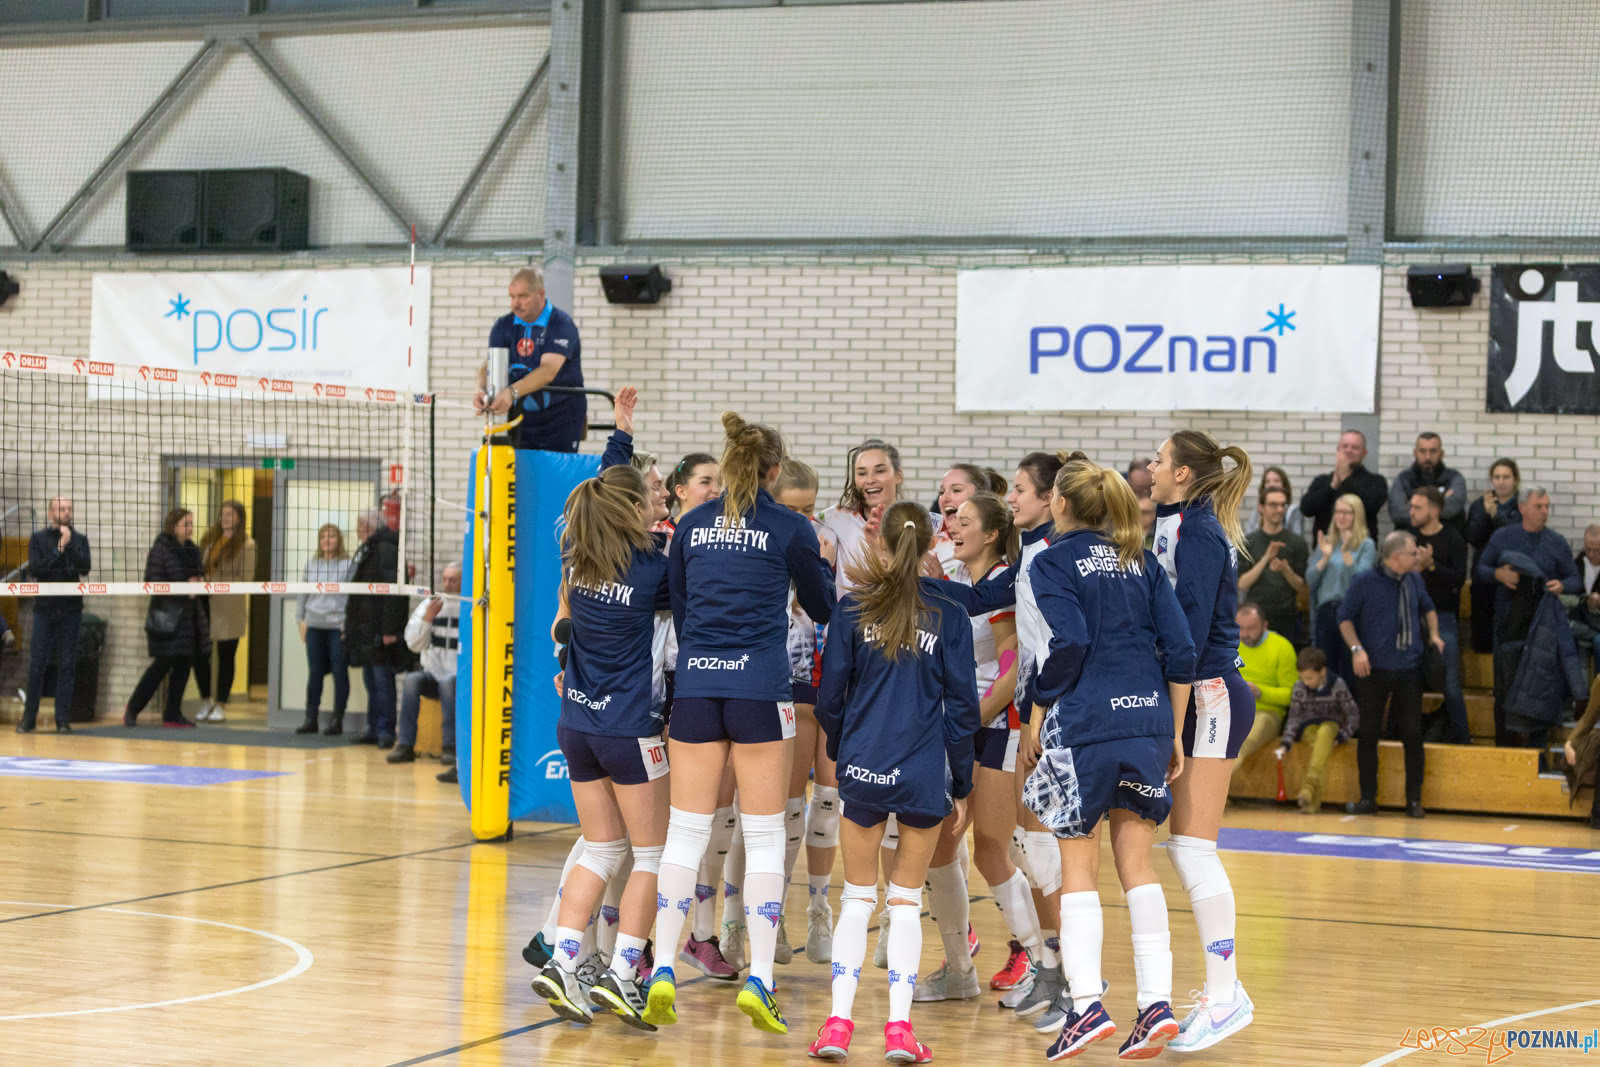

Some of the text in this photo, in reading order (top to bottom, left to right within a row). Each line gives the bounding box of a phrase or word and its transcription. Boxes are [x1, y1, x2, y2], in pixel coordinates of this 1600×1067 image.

[192, 295, 328, 365] posir
[1504, 269, 1600, 407] jt
[20, 355, 47, 369] ORLEN
[89, 362, 114, 375] ORLEN
[154, 368, 177, 381] ORLEN
[214, 374, 237, 387] ORLEN
[690, 527, 770, 552] ENERGETYK
[781, 706, 794, 725] 14
[647, 745, 663, 765] 10
